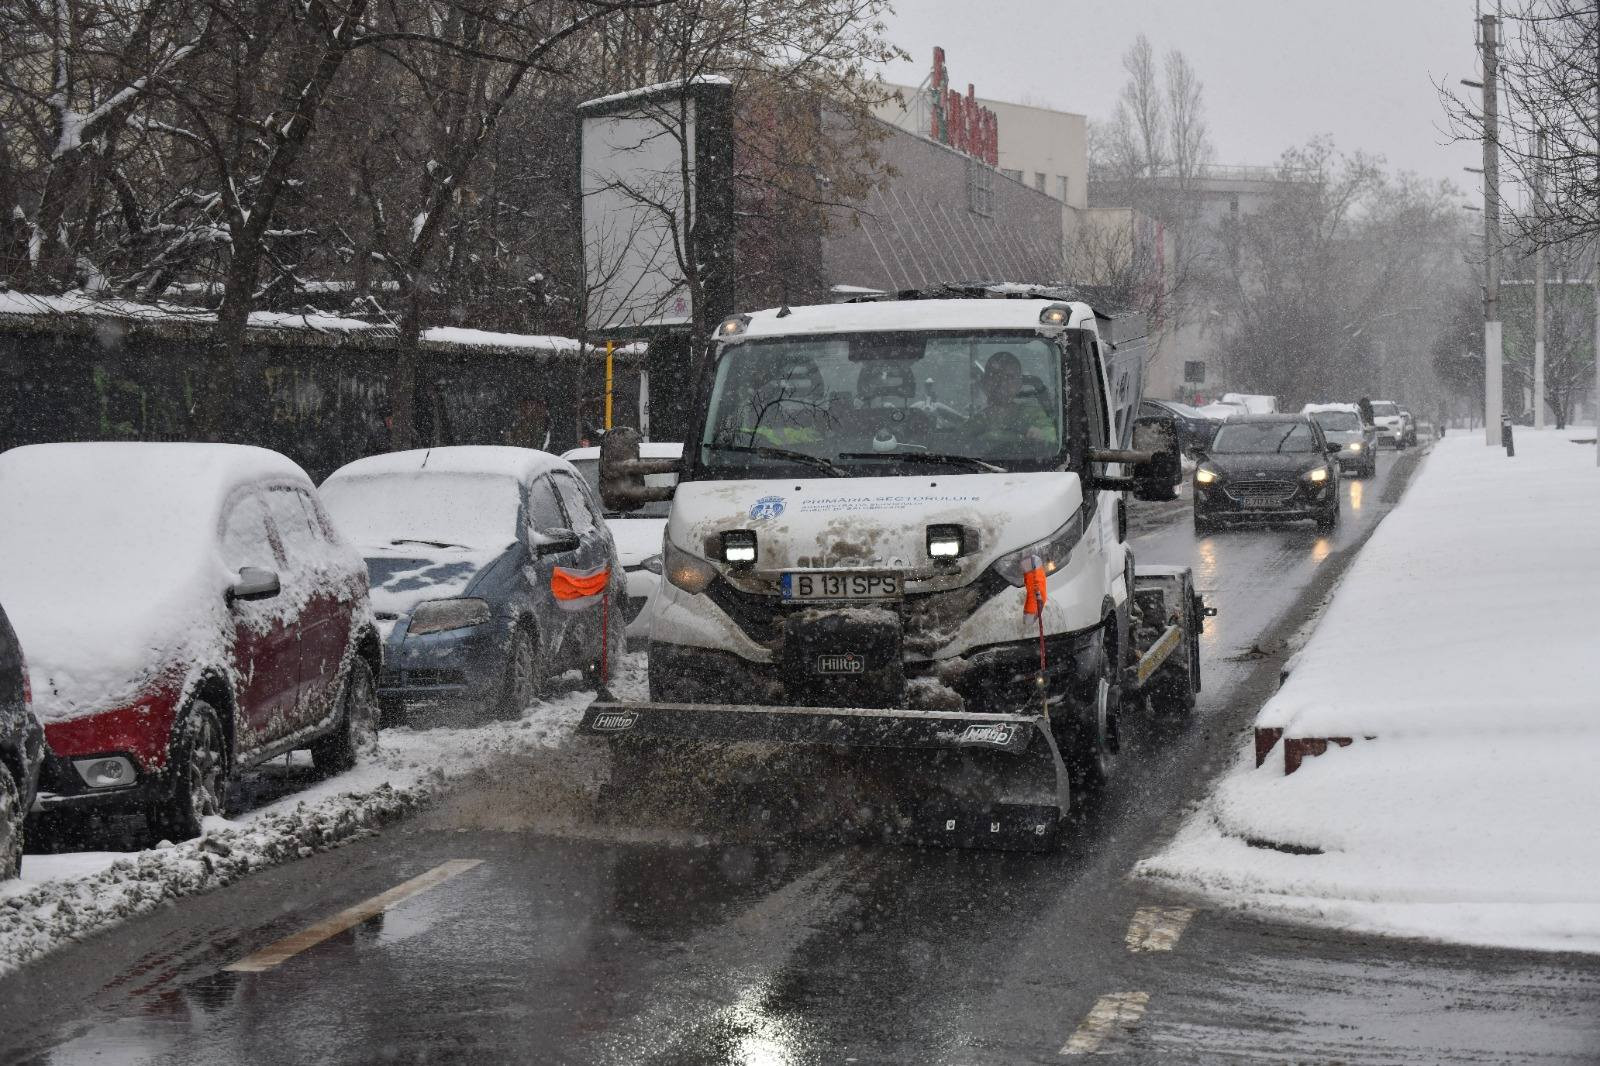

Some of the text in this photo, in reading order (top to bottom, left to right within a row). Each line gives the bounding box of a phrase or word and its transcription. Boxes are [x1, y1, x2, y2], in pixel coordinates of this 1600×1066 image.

[798, 575, 896, 596] B 131 SPS
[822, 657, 861, 673] Hilltip
[597, 715, 633, 729] Hilltip
